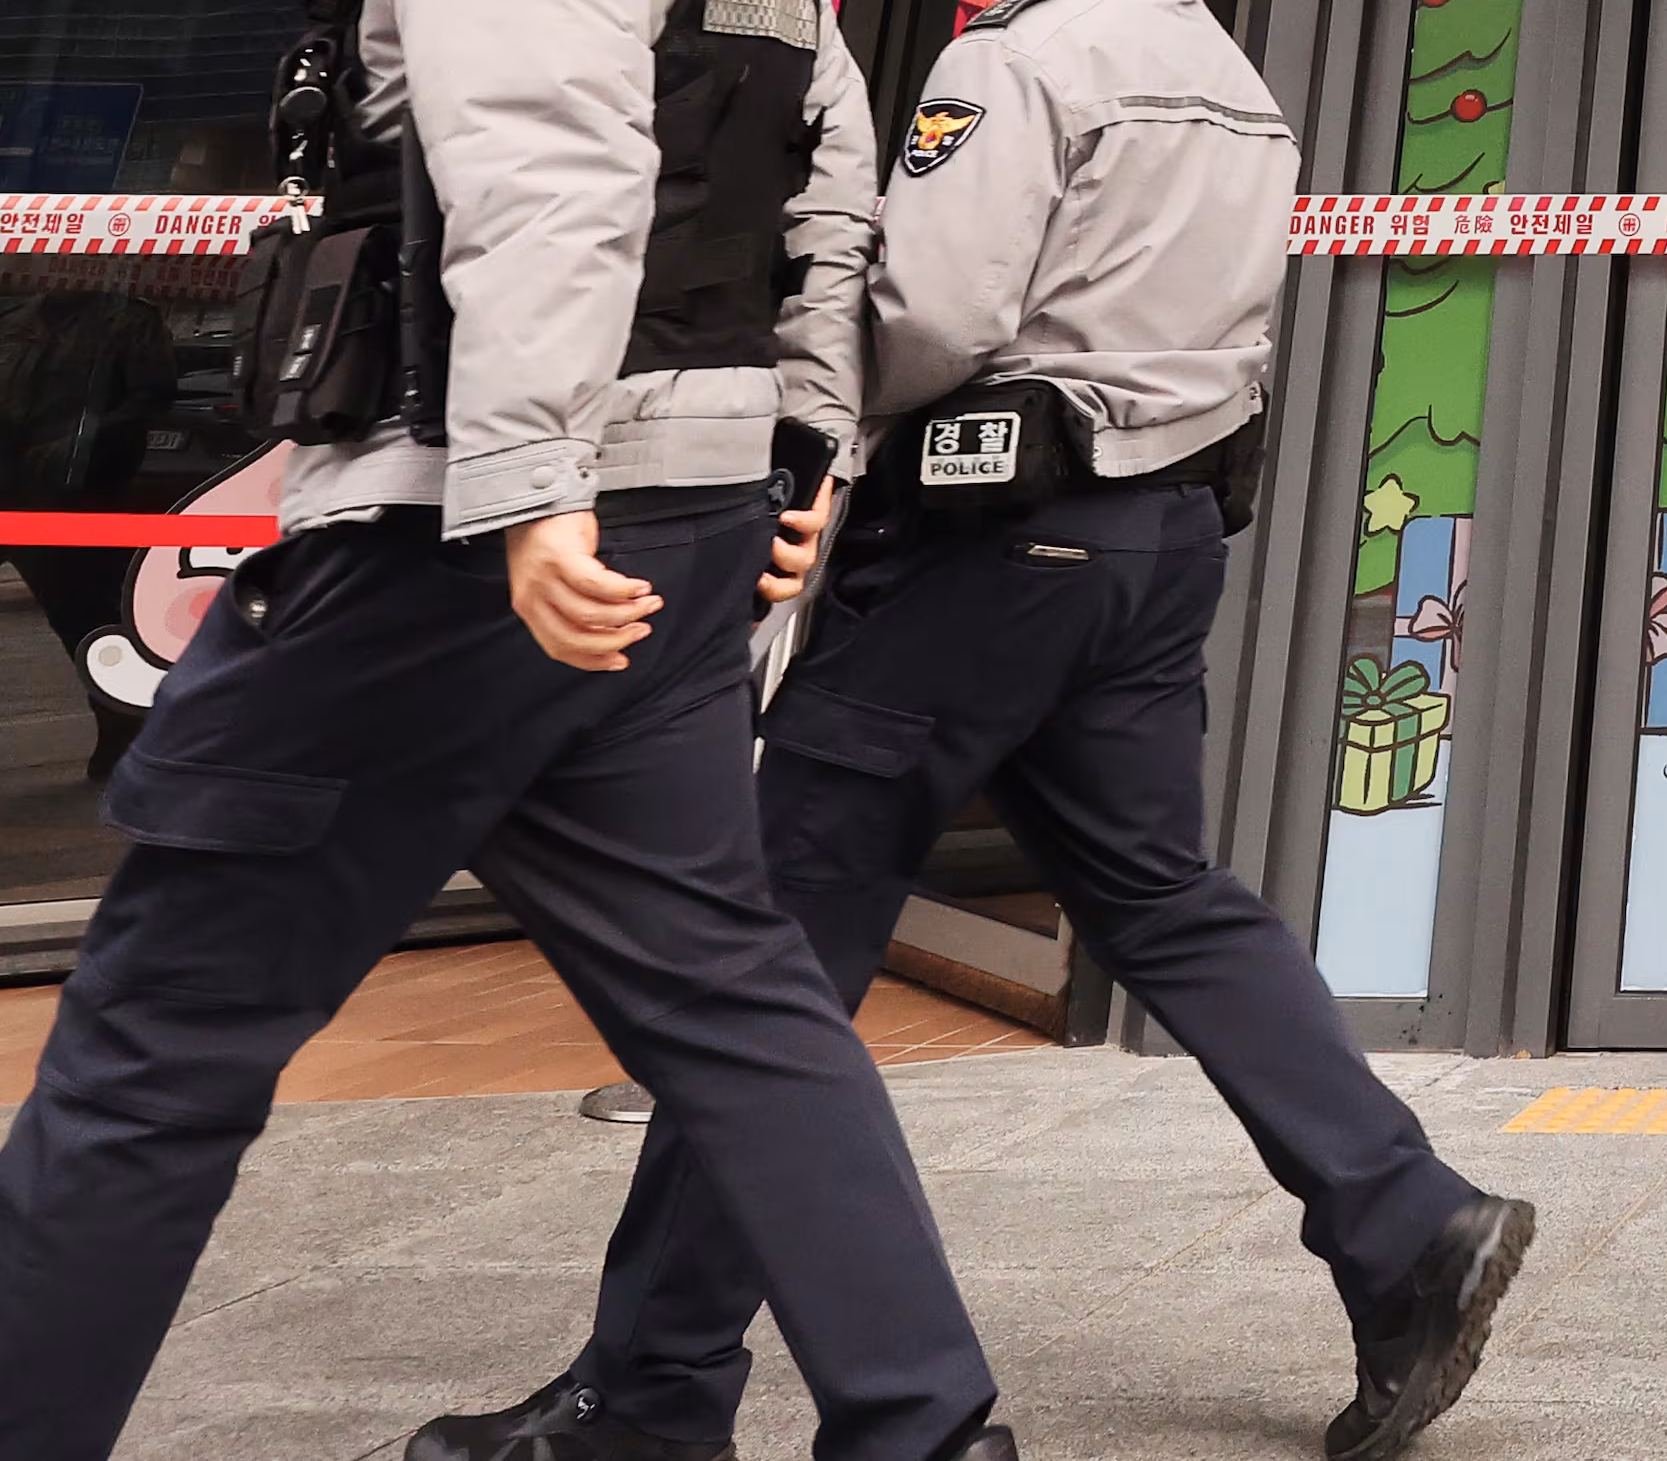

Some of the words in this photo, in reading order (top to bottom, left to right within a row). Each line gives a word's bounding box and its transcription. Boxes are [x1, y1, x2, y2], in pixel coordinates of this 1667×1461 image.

[0, 212, 85, 234] 안전제일
[154, 215, 243, 234] DANGER
[1288, 215, 1375, 235] DANGER
[1390, 214, 1430, 236] 위험
[1509, 214, 1593, 236] 안전제일
[934, 421, 1008, 454] 경찰
[931, 461, 1004, 476] POLICE
